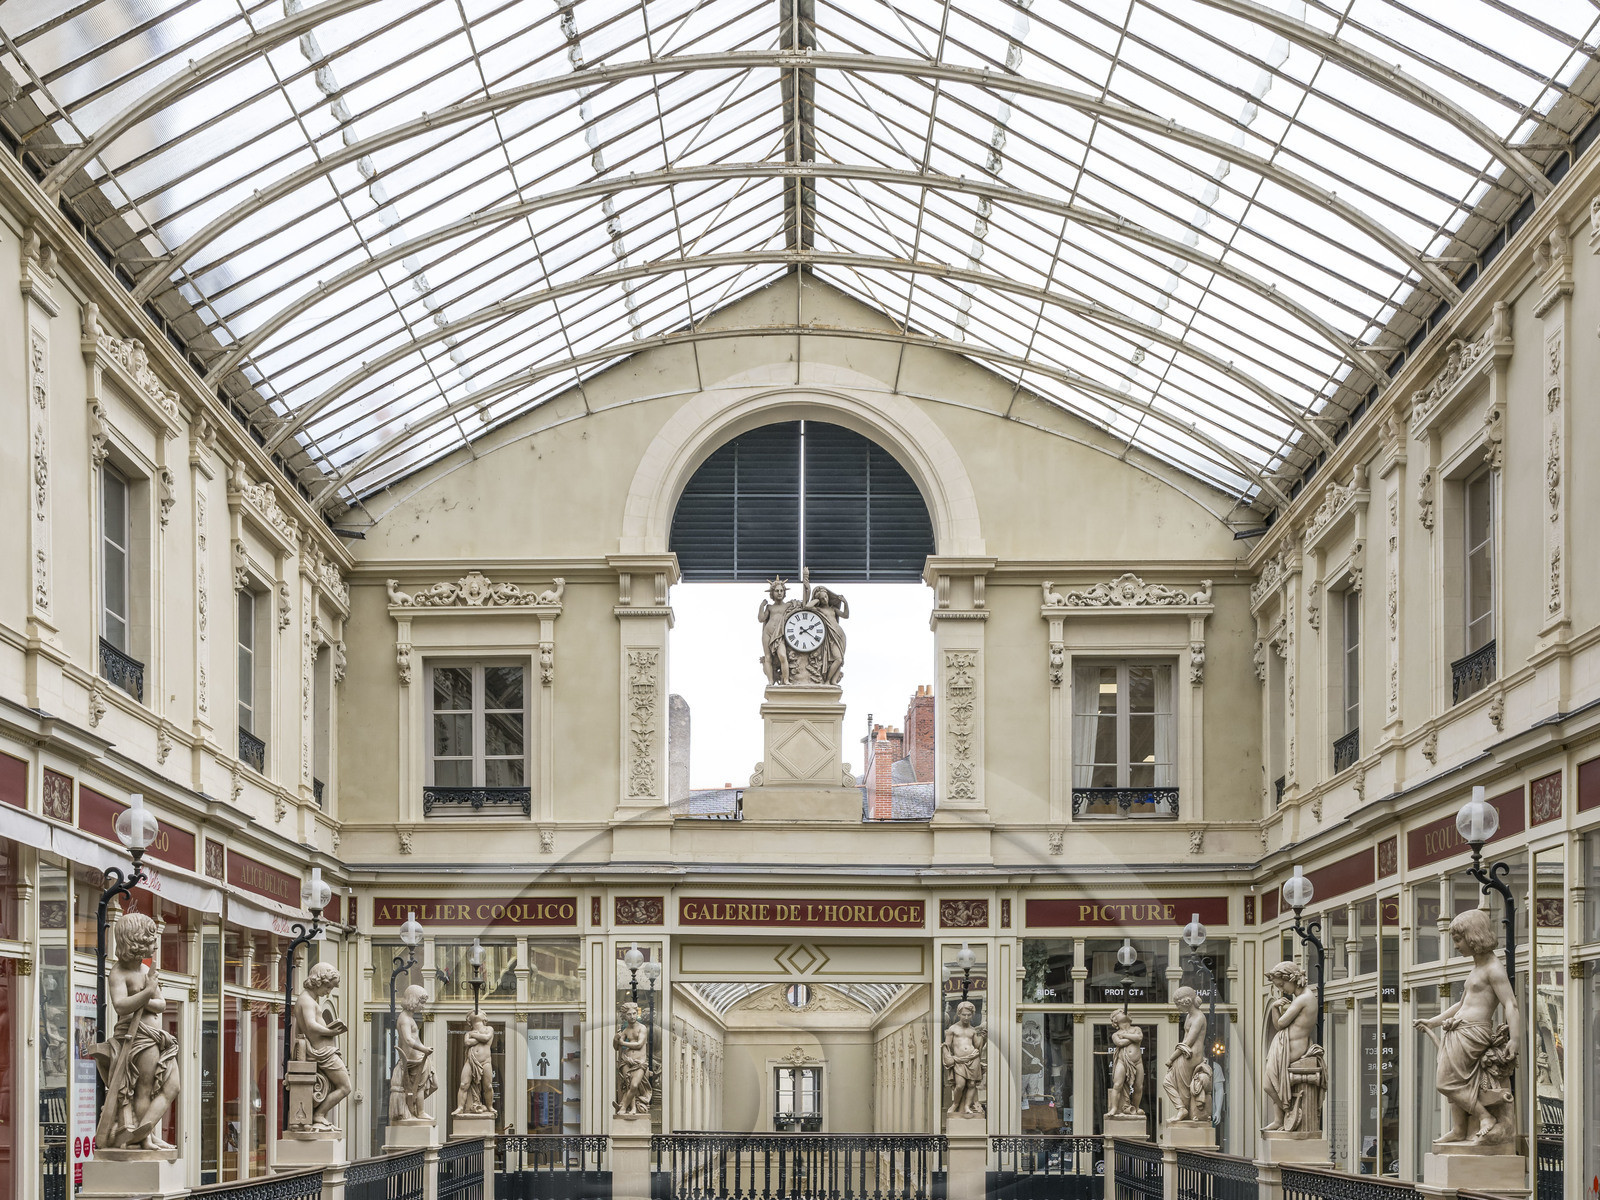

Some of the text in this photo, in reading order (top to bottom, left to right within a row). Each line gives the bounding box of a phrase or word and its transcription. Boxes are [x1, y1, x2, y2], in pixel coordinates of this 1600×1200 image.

[1425, 824, 1466, 856] ECOUT
[241, 864, 288, 898] ALICE DELICE
[378, 904, 574, 922] ATELIER COQLICO
[683, 903, 921, 922] GALERIE DE L'HORLOGE
[1079, 904, 1176, 921] PICTURE
